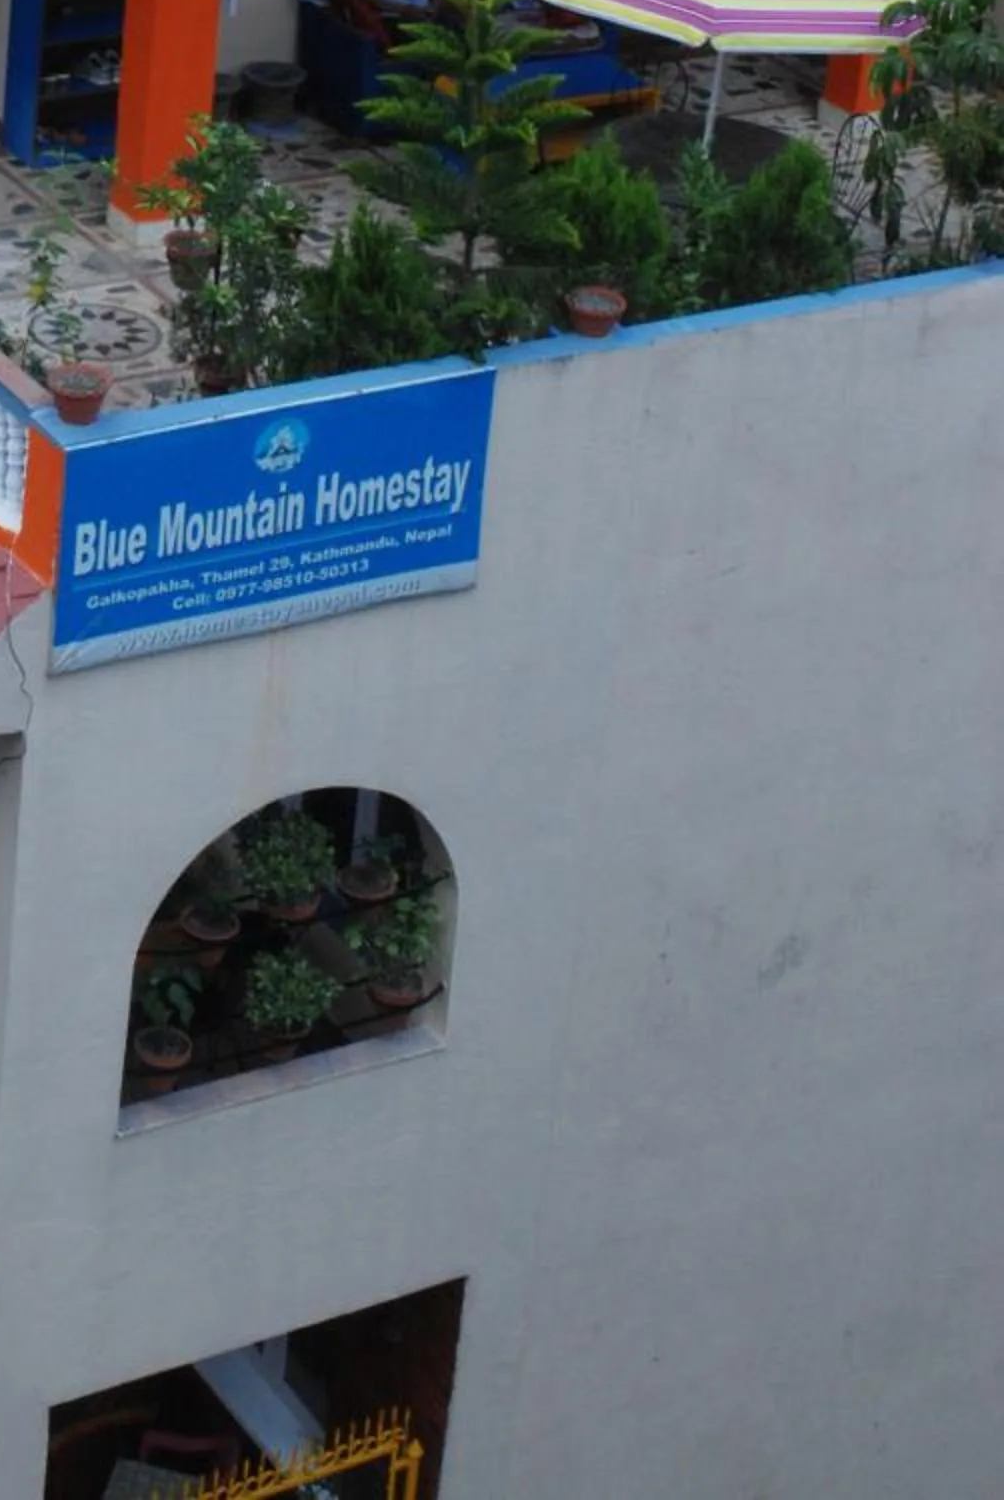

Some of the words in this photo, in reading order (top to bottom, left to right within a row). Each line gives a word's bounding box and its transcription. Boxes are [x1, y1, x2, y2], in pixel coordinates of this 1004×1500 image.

[73, 518, 147, 577] Blue
[157, 481, 306, 558] Mountain
[314, 455, 472, 526] Homestay
[201, 560, 266, 586] Thamel
[299, 535, 401, 565] Kathmandu,
[404, 523, 453, 544] Nepal
[172, 591, 210, 611] Cell:
